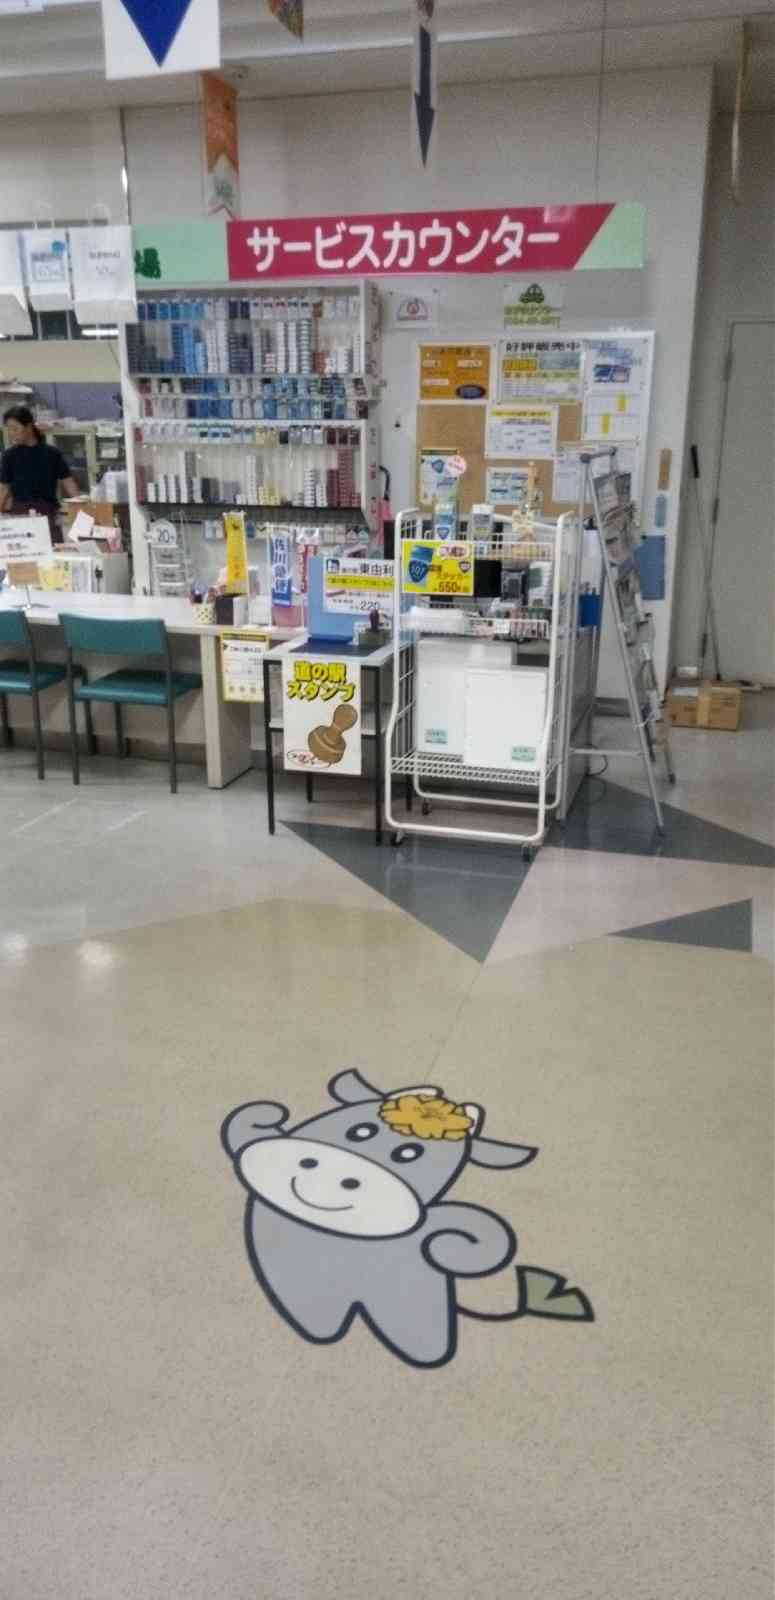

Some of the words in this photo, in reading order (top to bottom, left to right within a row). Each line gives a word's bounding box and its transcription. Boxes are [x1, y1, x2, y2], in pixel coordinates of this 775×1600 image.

[246, 214, 560, 273] サービスカウンター
[272, 537, 289, 594] 佐川急便
[286, 680, 357, 703] スタンプ
[293, 660, 348, 684] 道の駅
